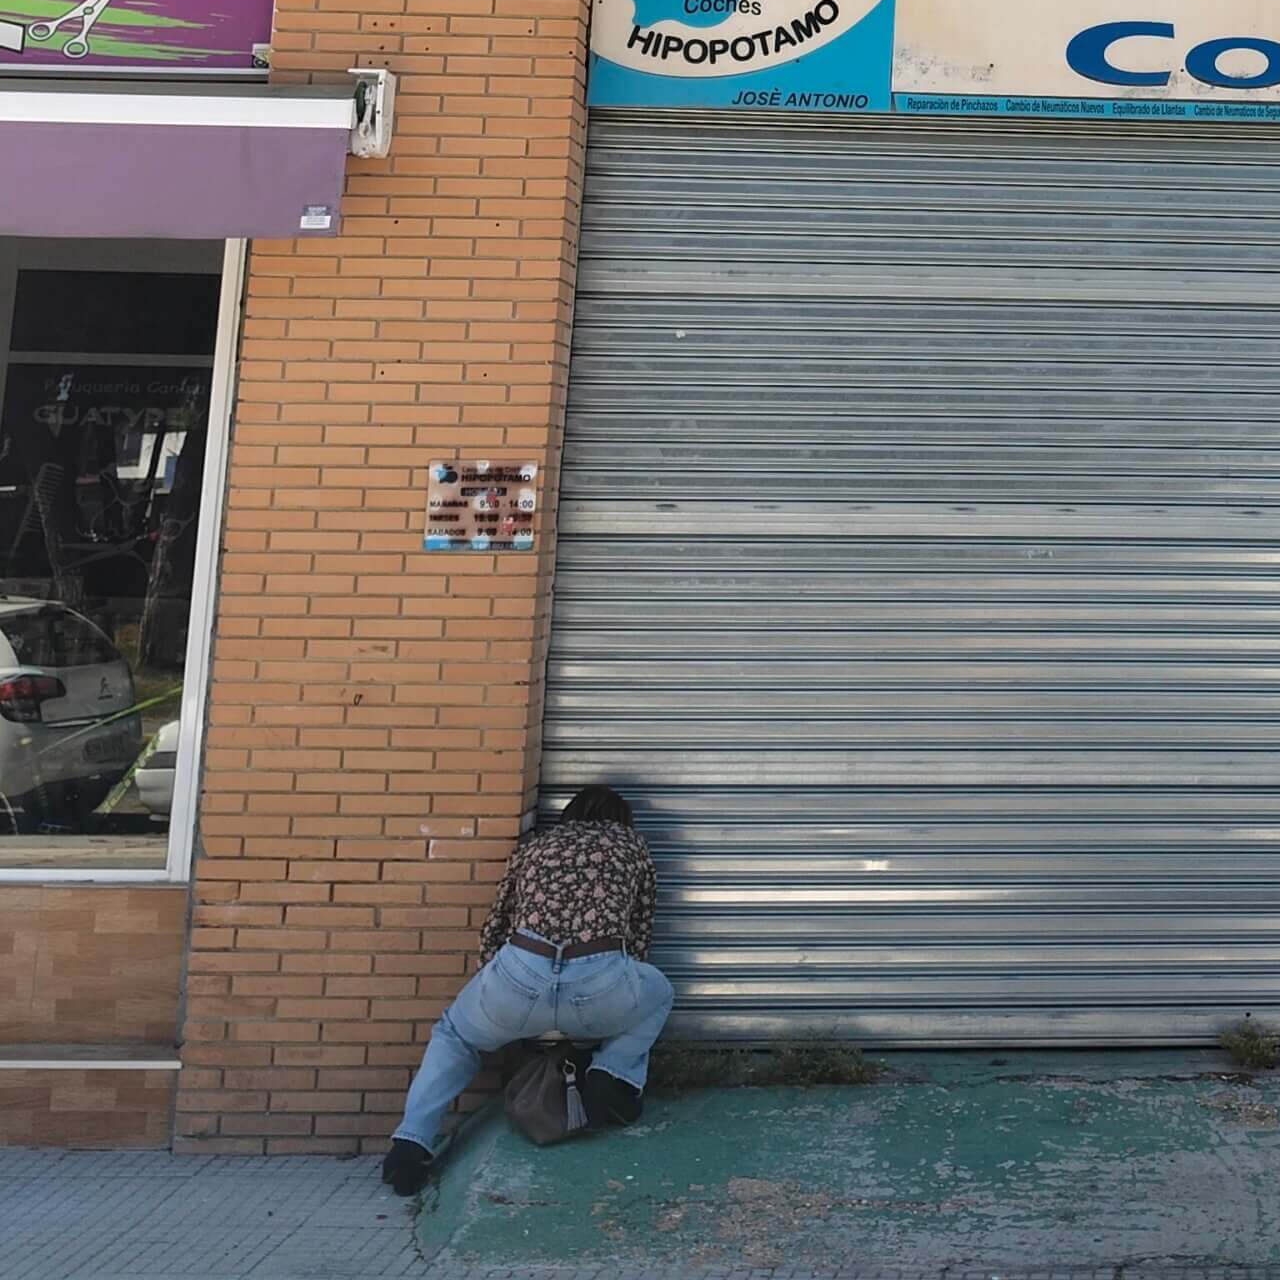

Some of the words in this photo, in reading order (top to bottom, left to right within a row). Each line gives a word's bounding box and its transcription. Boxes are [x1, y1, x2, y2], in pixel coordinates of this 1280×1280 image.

[627, 0, 839, 64] HIPOPOTAMO
[784, 92, 868, 108] ANTONIO
[951, 99, 960, 110] de
[961, 99, 998, 111] Pinchazos
[1006, 99, 1031, 111] Cambio
[1032, 100, 1040, 112] de
[1080, 101, 1105, 113] Nuevos
[1112, 103, 1150, 117] Equilibrado
[1151, 104, 1160, 115] de
[1161, 104, 1185, 115] Llantas
[1216, 105, 1223, 116] de
[1257, 106, 1264, 117] de
